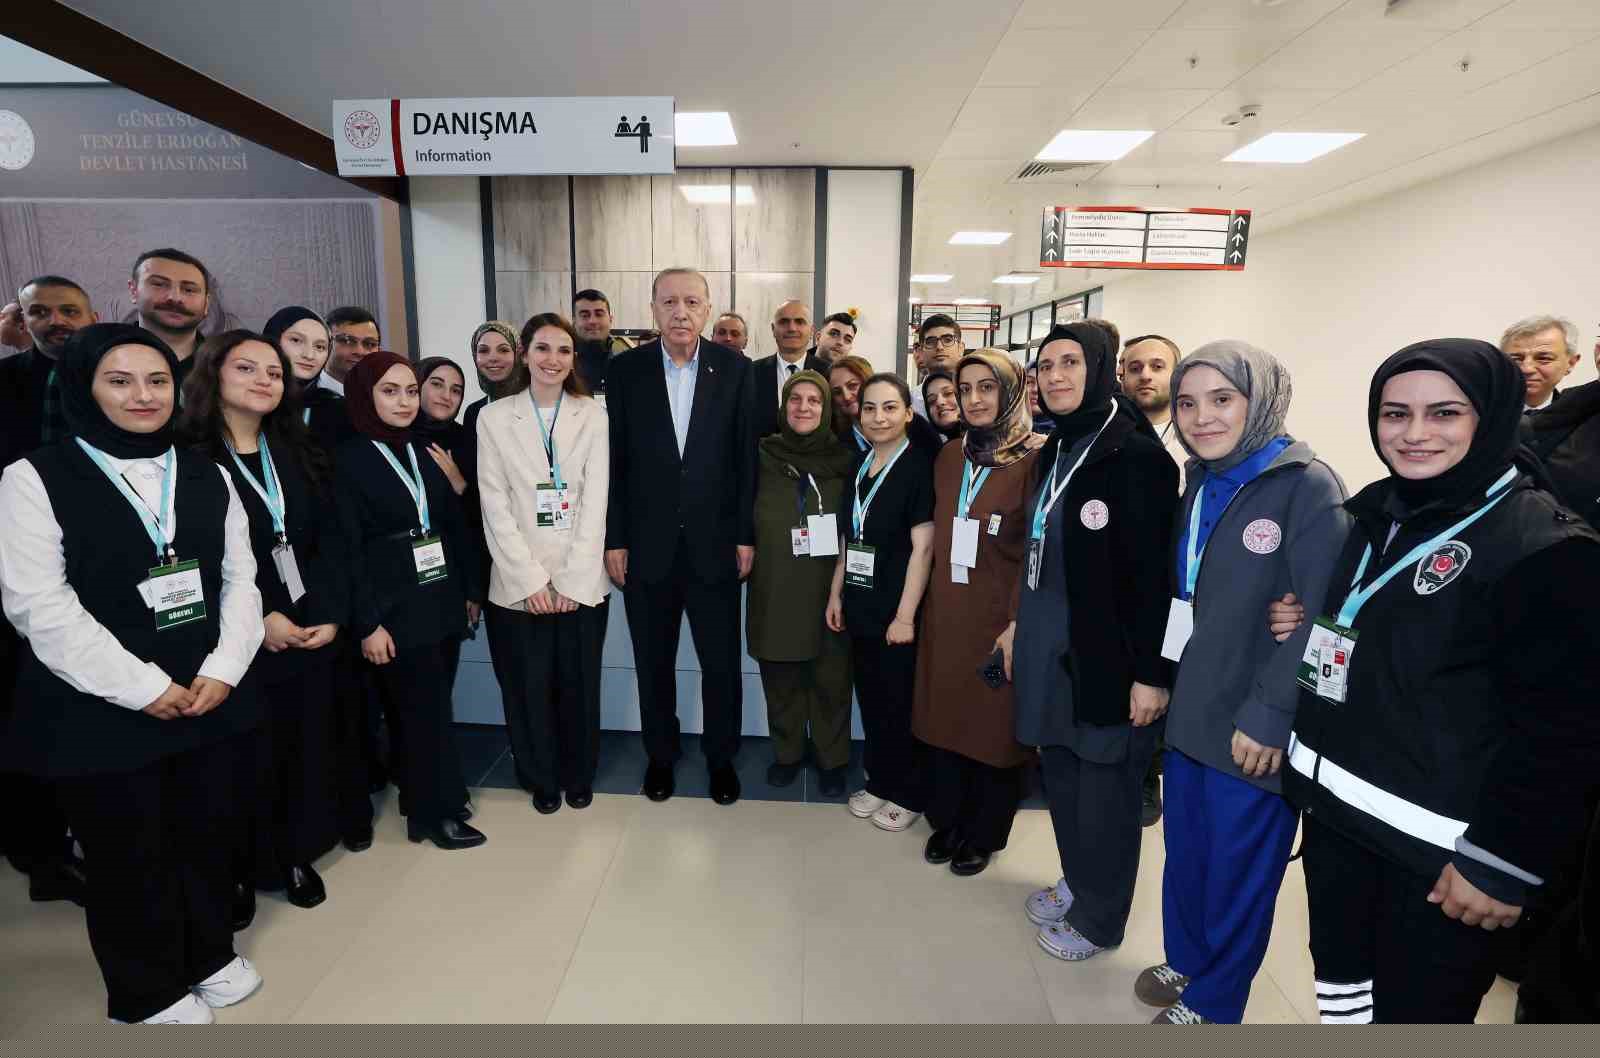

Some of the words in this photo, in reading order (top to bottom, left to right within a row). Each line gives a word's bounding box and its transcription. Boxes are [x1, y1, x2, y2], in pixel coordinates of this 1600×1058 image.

[413, 111, 538, 141] DANIŞMA
[80, 132, 153, 149] TENZİLE
[158, 130, 241, 149] ERDOĞAN
[80, 155, 145, 170] DEVLET
[151, 152, 248, 170] HASTANESİ
[415, 148, 492, 162] Information
